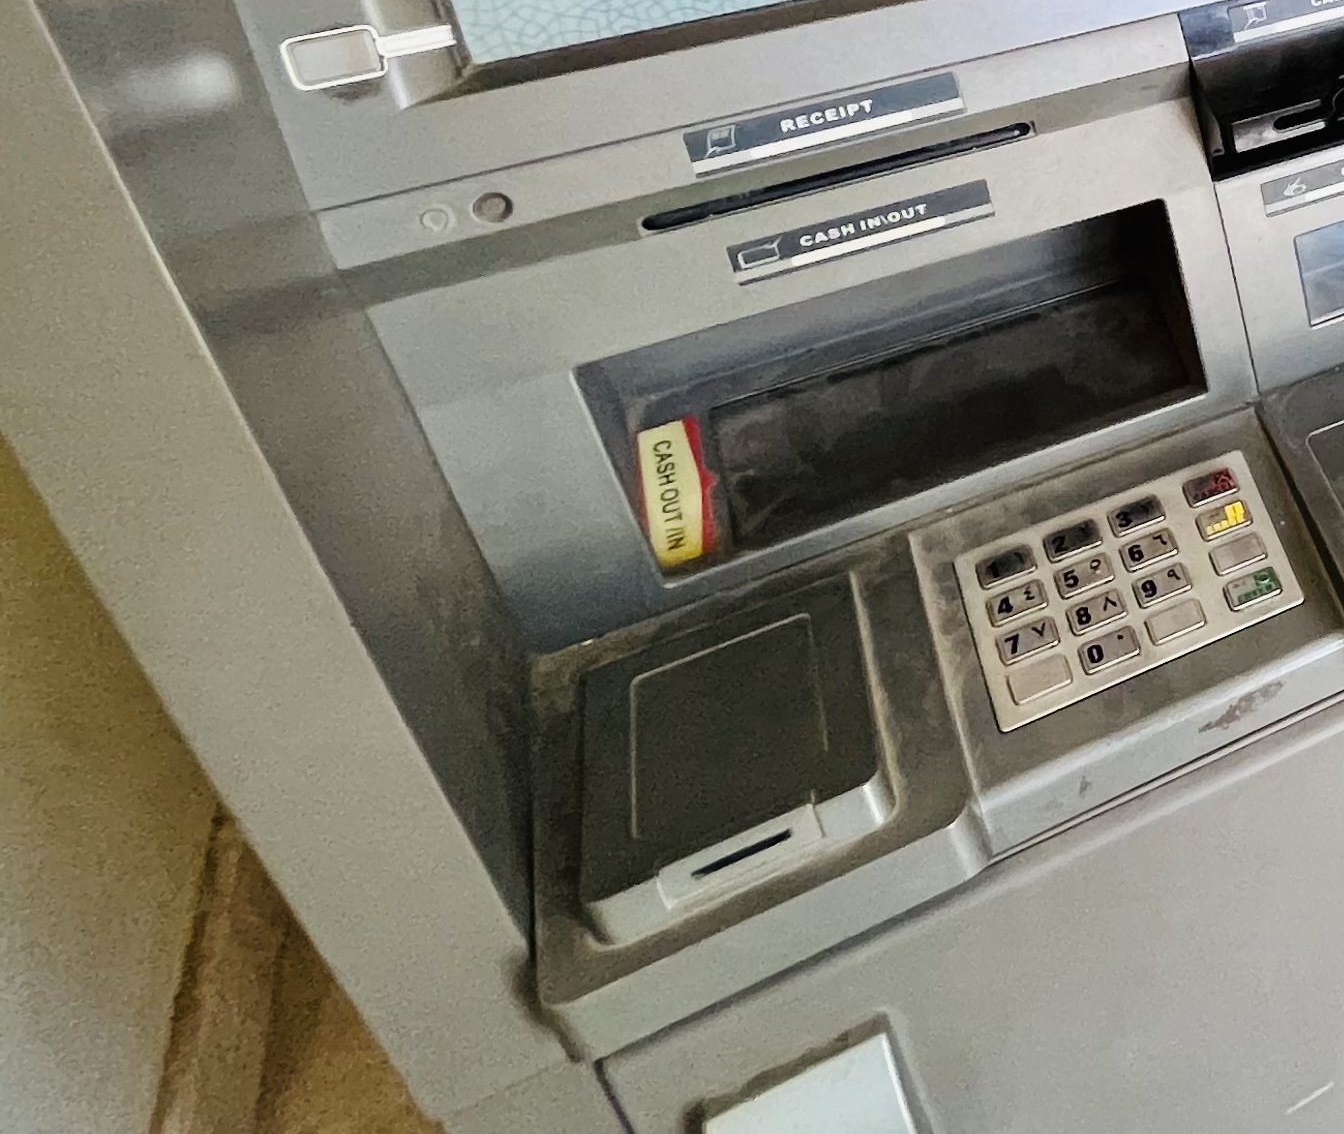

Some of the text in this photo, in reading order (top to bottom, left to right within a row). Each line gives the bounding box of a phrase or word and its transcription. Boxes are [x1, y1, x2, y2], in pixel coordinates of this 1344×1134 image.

[780, 99, 873, 133] RECEIPT
[799, 223, 856, 247] CASH
[652, 440, 676, 487] CASH
[660, 488, 682, 523] OUT
[1115, 511, 1133, 528] 3
[1052, 536, 1066, 554] 2
[1127, 544, 1144, 562] 6
[1063, 570, 1079, 588] 5
[1140, 579, 1157, 598] 9
[997, 596, 1014, 614] 4
[1075, 606, 1092, 626] 8
[1003, 633, 1020, 654] 7
[1086, 644, 1104, 664] 0
